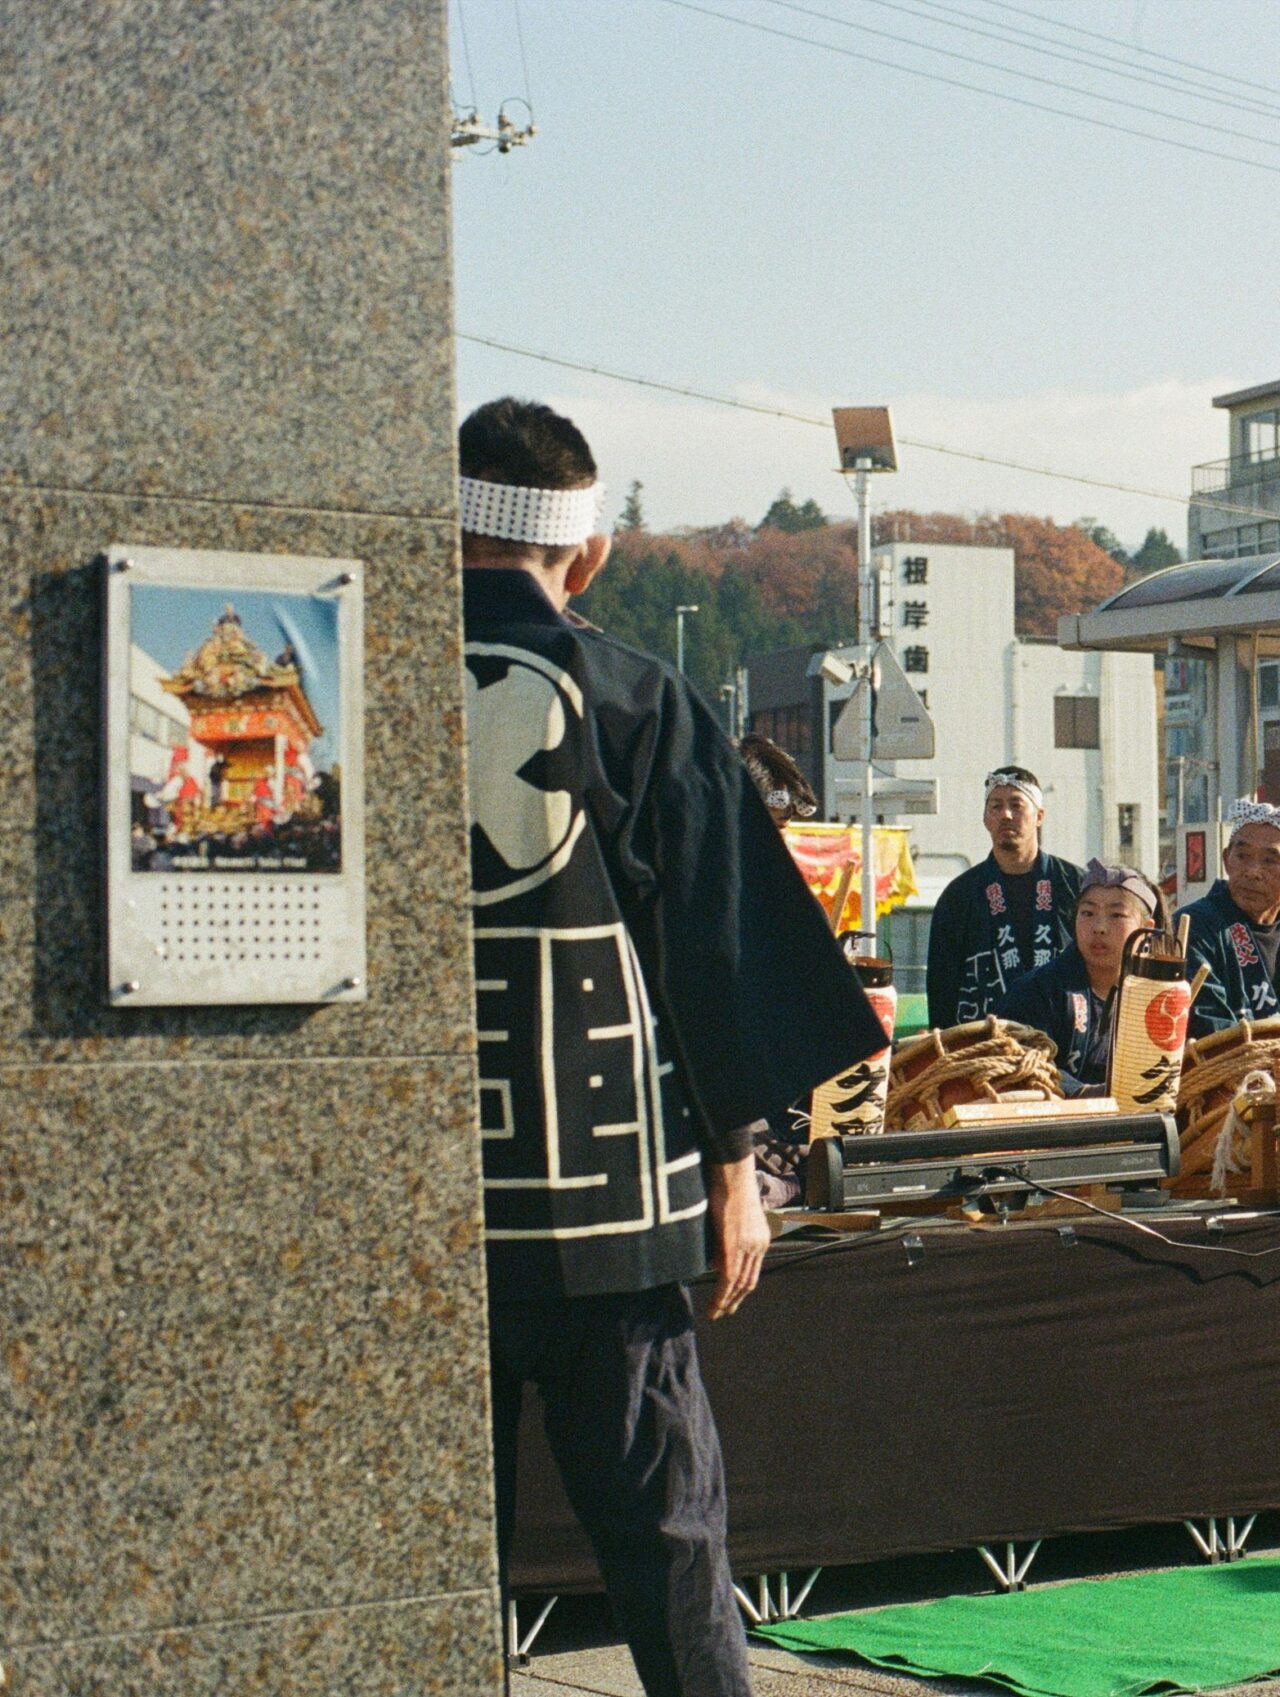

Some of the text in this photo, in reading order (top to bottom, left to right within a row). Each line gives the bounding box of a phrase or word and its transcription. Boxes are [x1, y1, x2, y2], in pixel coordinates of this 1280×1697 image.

[903, 556, 930, 711] 根岸歯
[1230, 922, 1259, 968] 秩父
